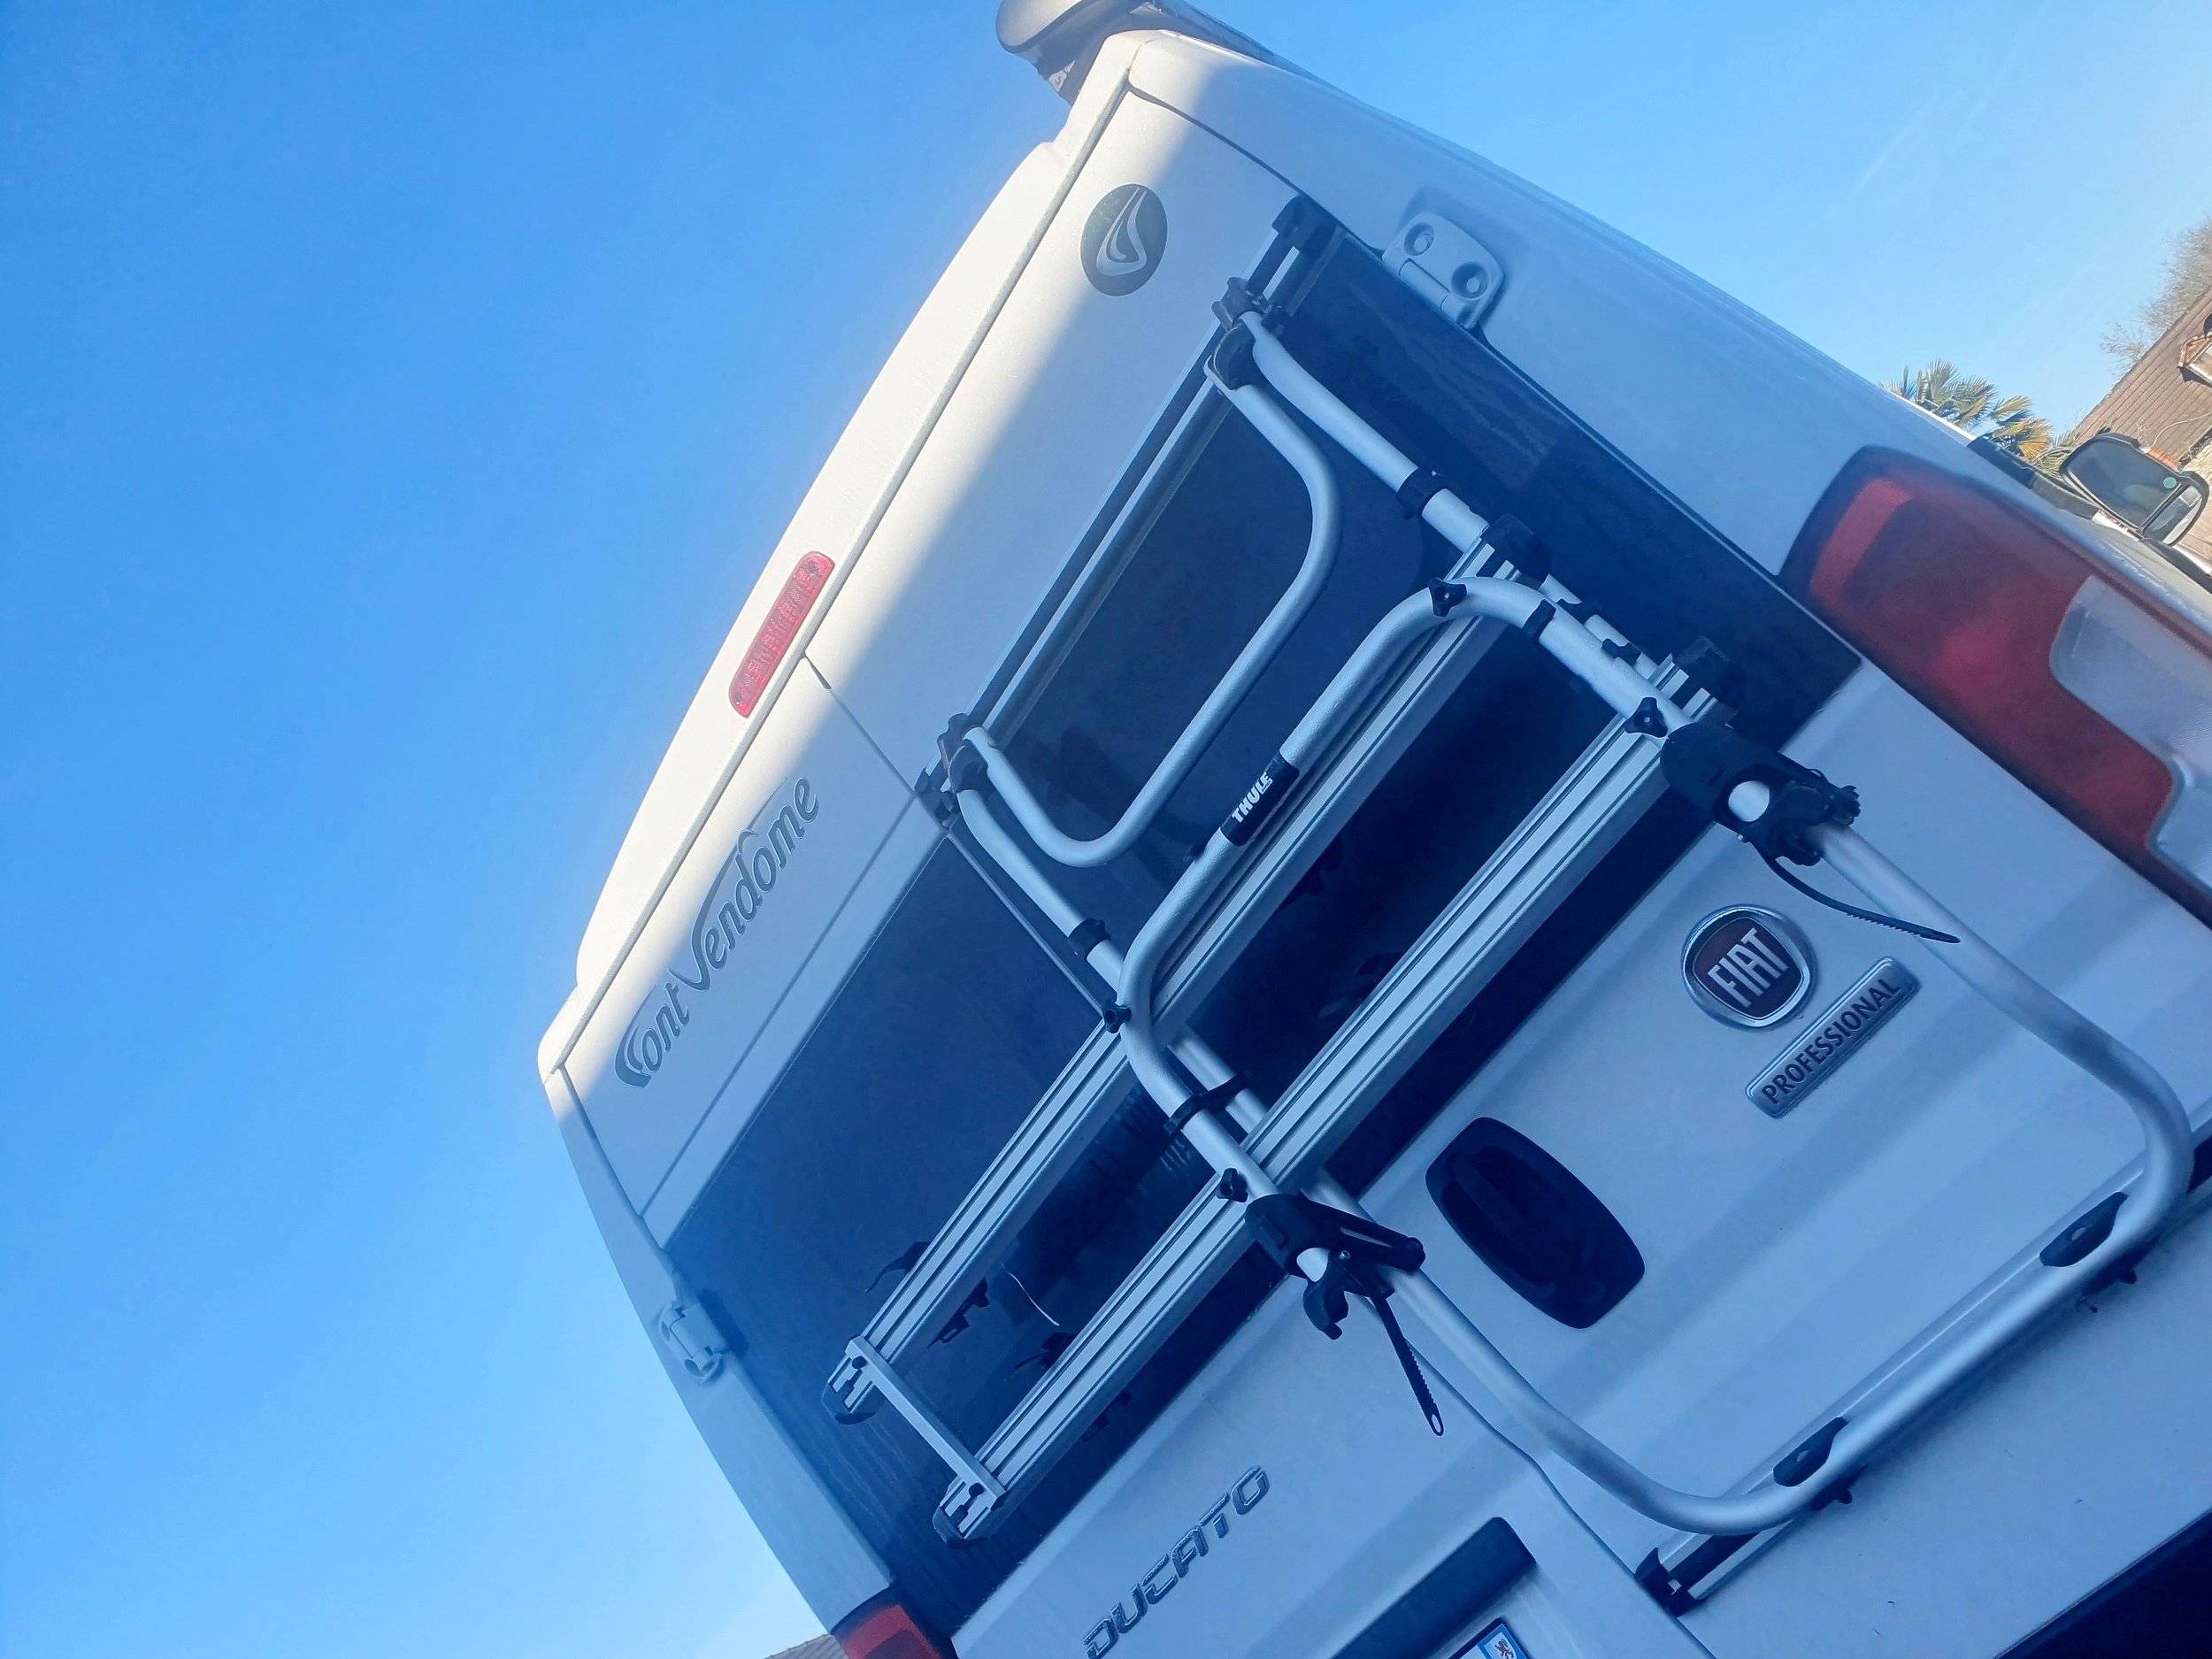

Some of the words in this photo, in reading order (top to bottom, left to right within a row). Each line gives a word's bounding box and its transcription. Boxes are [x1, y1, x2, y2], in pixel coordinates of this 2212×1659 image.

[1232, 771, 1273, 823] THULE
[1707, 927, 1790, 1009] FIAT
[1761, 978, 1901, 1105] PROFESSIONAL
[1083, 1465, 1270, 1659] DUCATO
